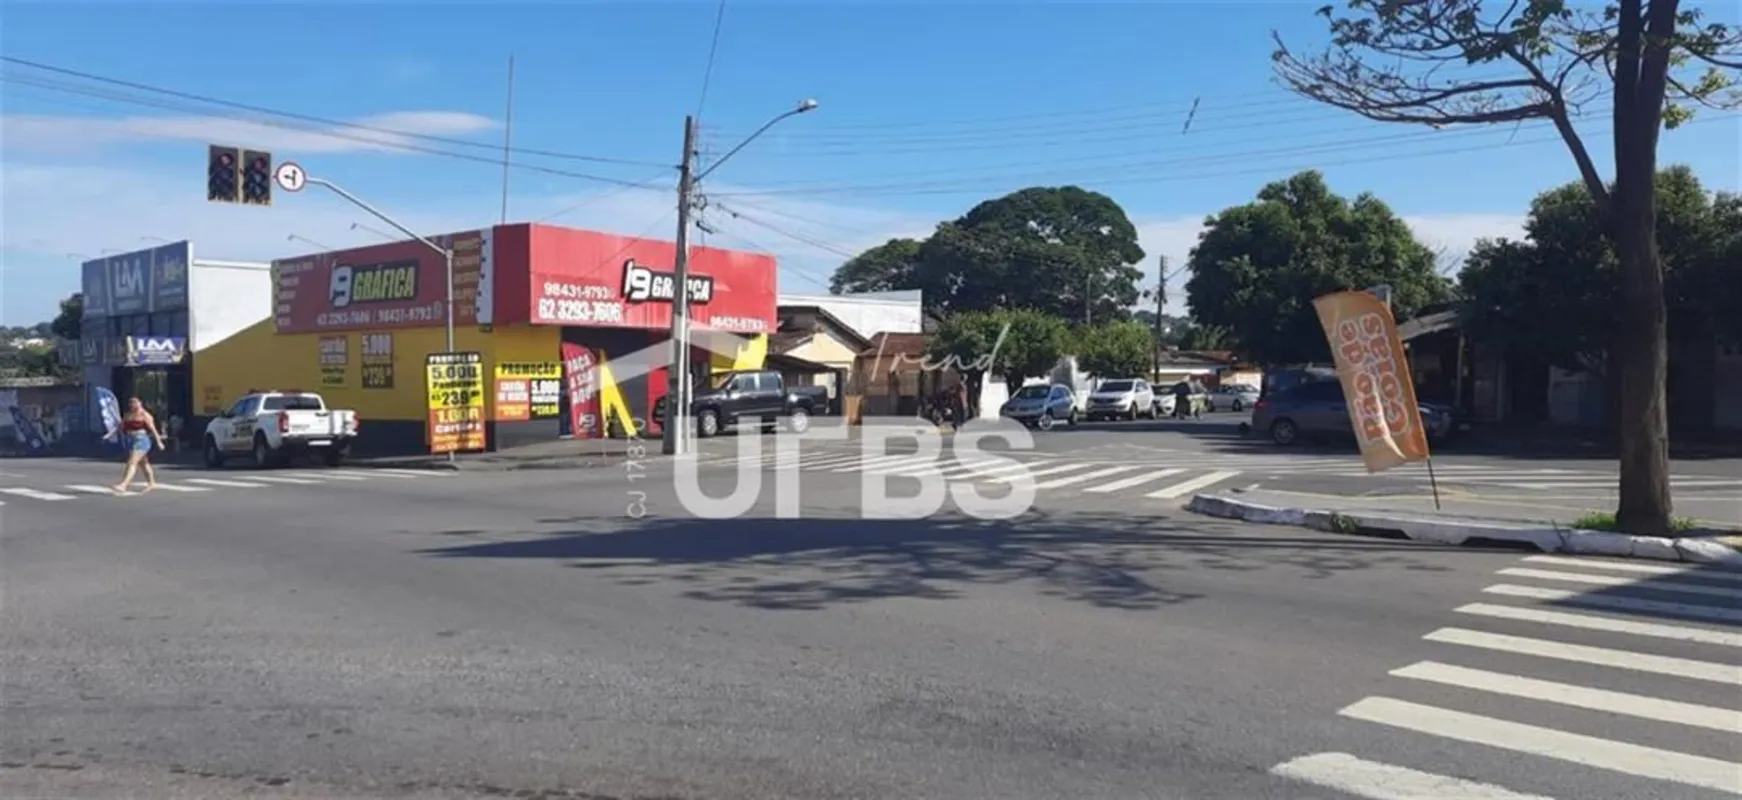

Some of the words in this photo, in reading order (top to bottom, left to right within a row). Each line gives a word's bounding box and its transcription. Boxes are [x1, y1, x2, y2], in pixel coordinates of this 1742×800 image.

[539, 298, 555, 320] 62
[557, 300, 621, 323] 3293-7606
[501, 361, 556, 375] PROMOÇÃO
